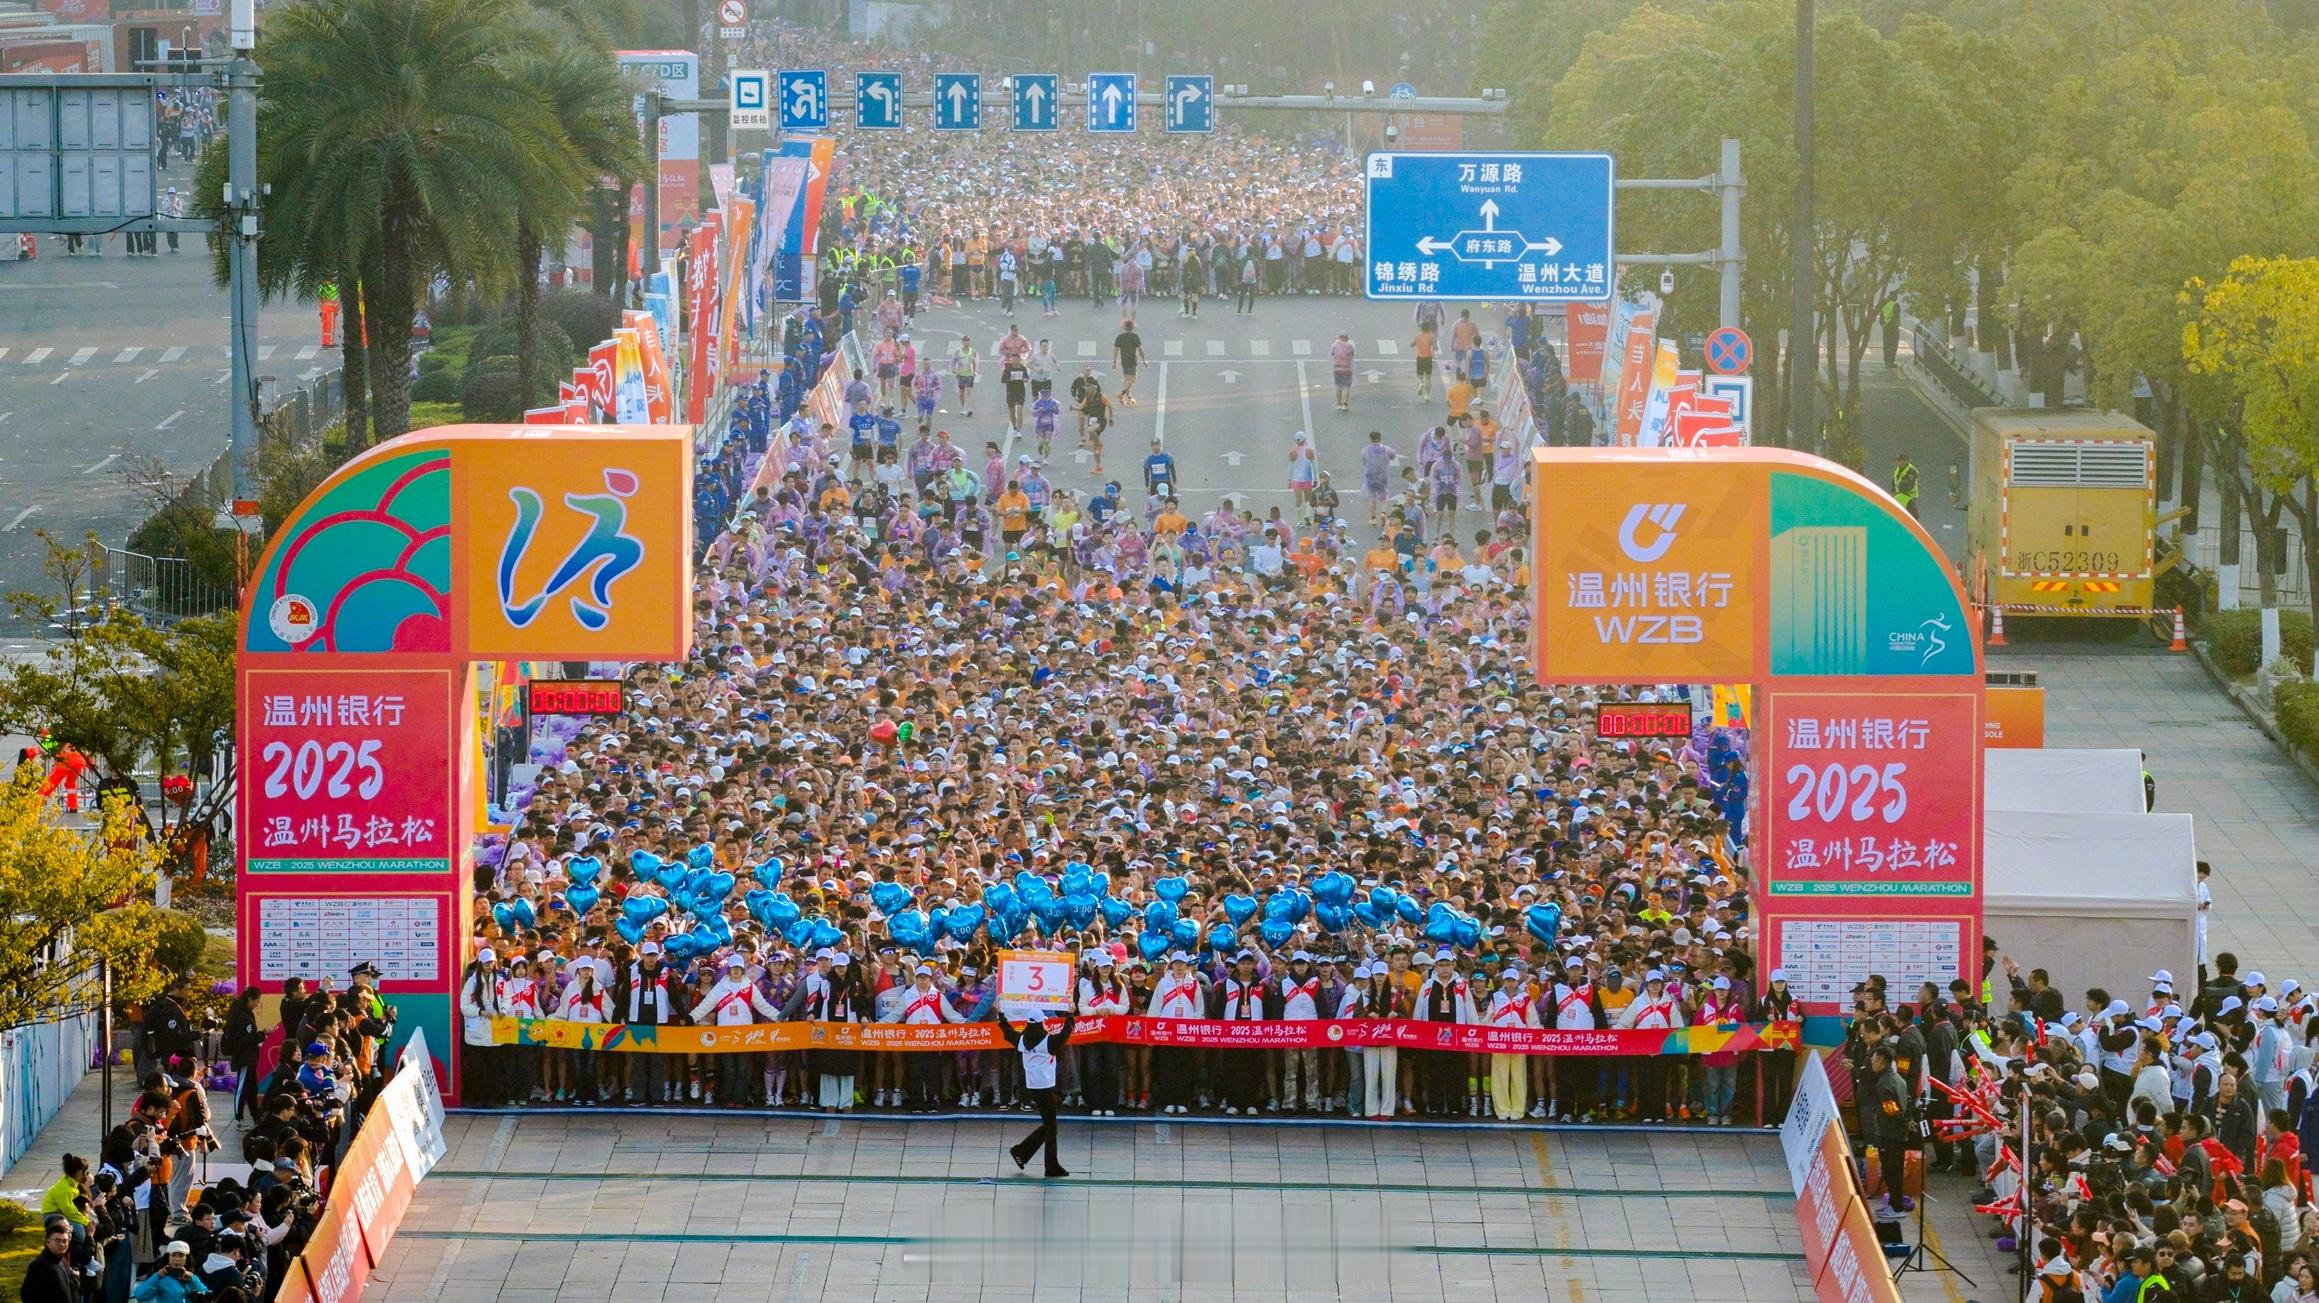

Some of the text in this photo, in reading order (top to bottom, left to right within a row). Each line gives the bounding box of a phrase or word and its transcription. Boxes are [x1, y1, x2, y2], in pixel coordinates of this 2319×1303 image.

[733, 115, 767, 124] 监控抓拍
[1375, 158, 1388, 173] 东
[1459, 163, 1523, 183] 万源路
[1461, 185, 1518, 193] Wanyuan Rd.
[1466, 239, 1512, 254] 府东路
[1375, 262, 1440, 283] 锦绣路
[1518, 263, 1604, 283] 温州大道
[1378, 284, 1436, 293] Jinxiu Rd.
[1523, 285, 1603, 294] Wenzhou Ave.
[2018, 551, 2119, 571] 浙C52309
[1568, 572, 1733, 609] 温州银行
[1594, 616, 1703, 644] WZB
[1889, 632, 1925, 641] CHINA
[263, 694, 405, 726] 温州银行
[532, 691, 620, 712] 00:00:00
[1600, 714, 1690, 735] 00:00:00
[1787, 718, 1930, 749] 温州银行
[263, 740, 383, 800] 2025
[1786, 763, 1907, 823] 2025
[263, 814, 434, 850] 温州马拉松
[1786, 836, 1957, 872] 温州马拉松
[254, 861, 444, 869] WZB 2025 WENZHOU MARATHON
[1776, 883, 1967, 892] WZB 2025 WENZHOU MARATHON
[1027, 966, 1044, 991] 3
